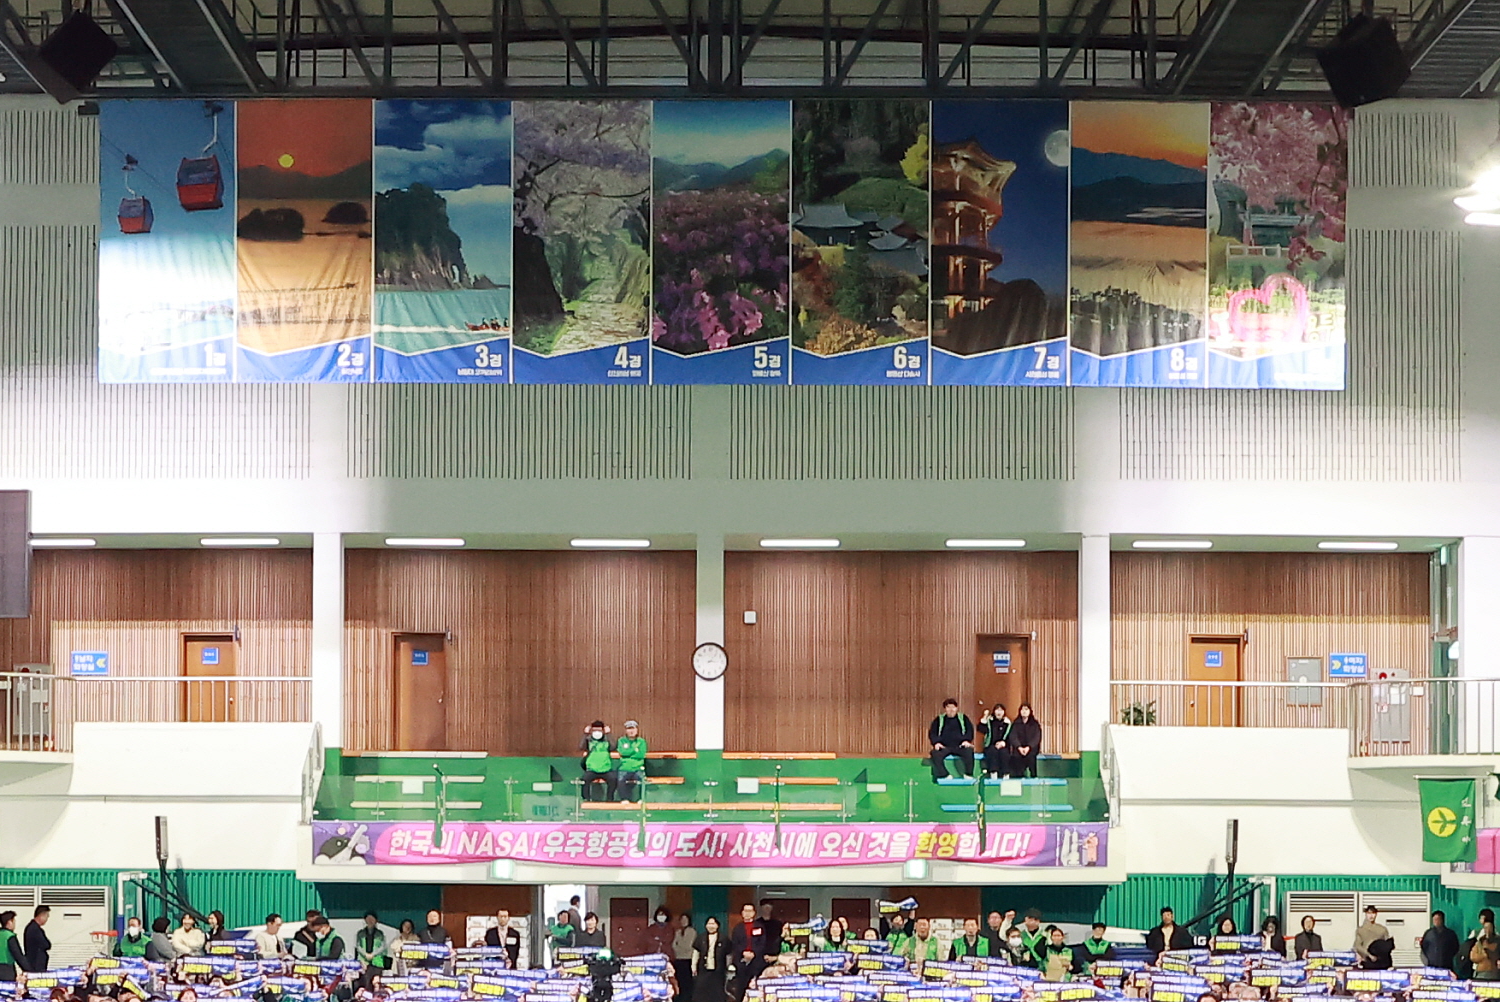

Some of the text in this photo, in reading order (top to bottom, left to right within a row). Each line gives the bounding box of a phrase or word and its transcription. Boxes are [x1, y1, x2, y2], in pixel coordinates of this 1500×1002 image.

[337, 343, 364, 366] 2경
[474, 344, 502, 368] 3경
[614, 345, 641, 369] 4경
[754, 345, 781, 369] 5경
[893, 345, 920, 369] 6경
[1034, 346, 1060, 370] 7경
[457, 830, 542, 857] NASA!
[674, 831, 728, 858] 도시!
[819, 832, 864, 858] 오신
[867, 831, 911, 859] 것을
[914, 831, 1032, 859] 환영합니다!
